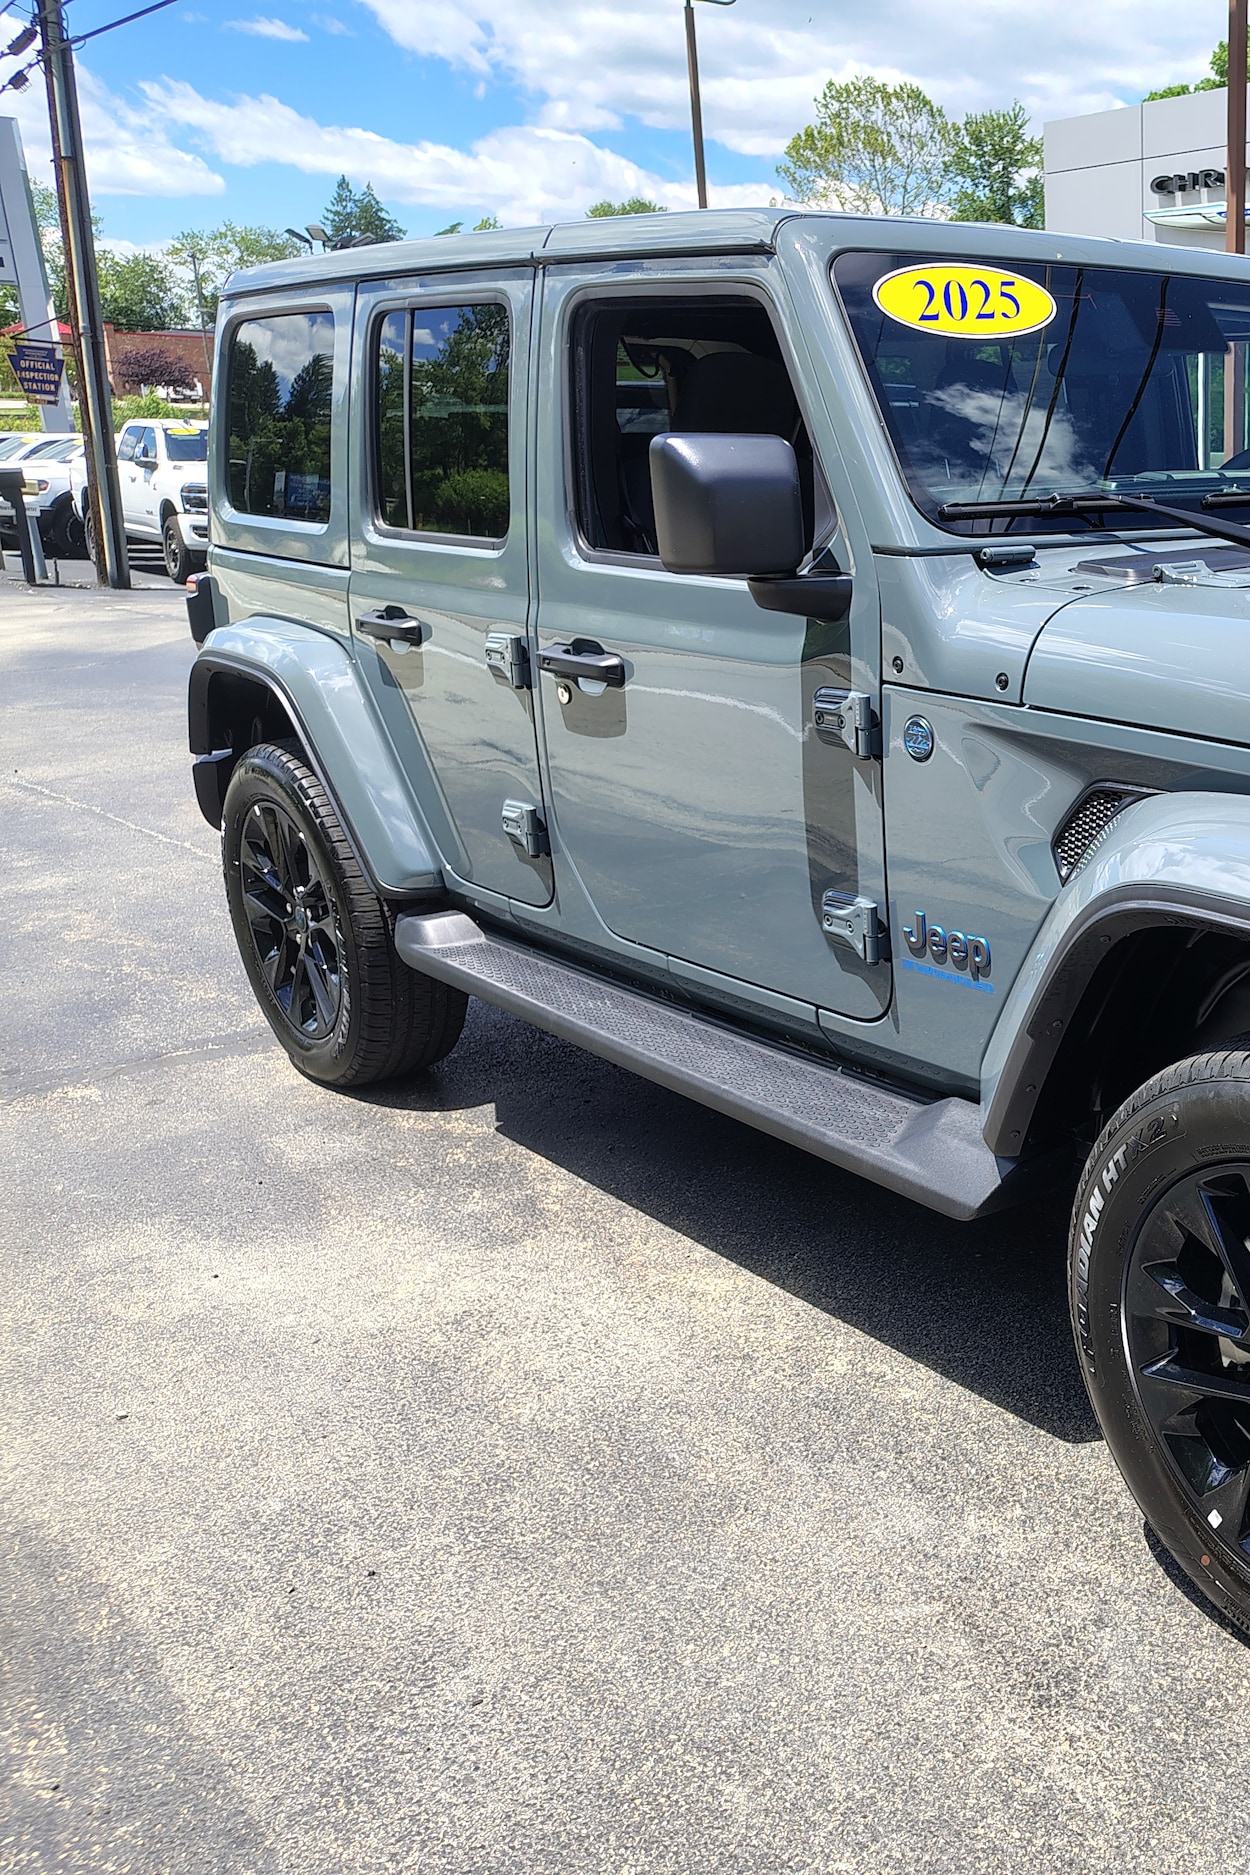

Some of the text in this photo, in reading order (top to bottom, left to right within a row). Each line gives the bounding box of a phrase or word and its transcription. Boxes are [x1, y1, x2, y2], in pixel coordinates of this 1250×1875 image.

[912, 279, 1021, 322] 2025
[20, 360, 56, 371] OFFICIAL
[17, 370, 59, 382] INSPECTION
[23, 381, 56, 392] STATION
[903, 909, 991, 976] Jeep
